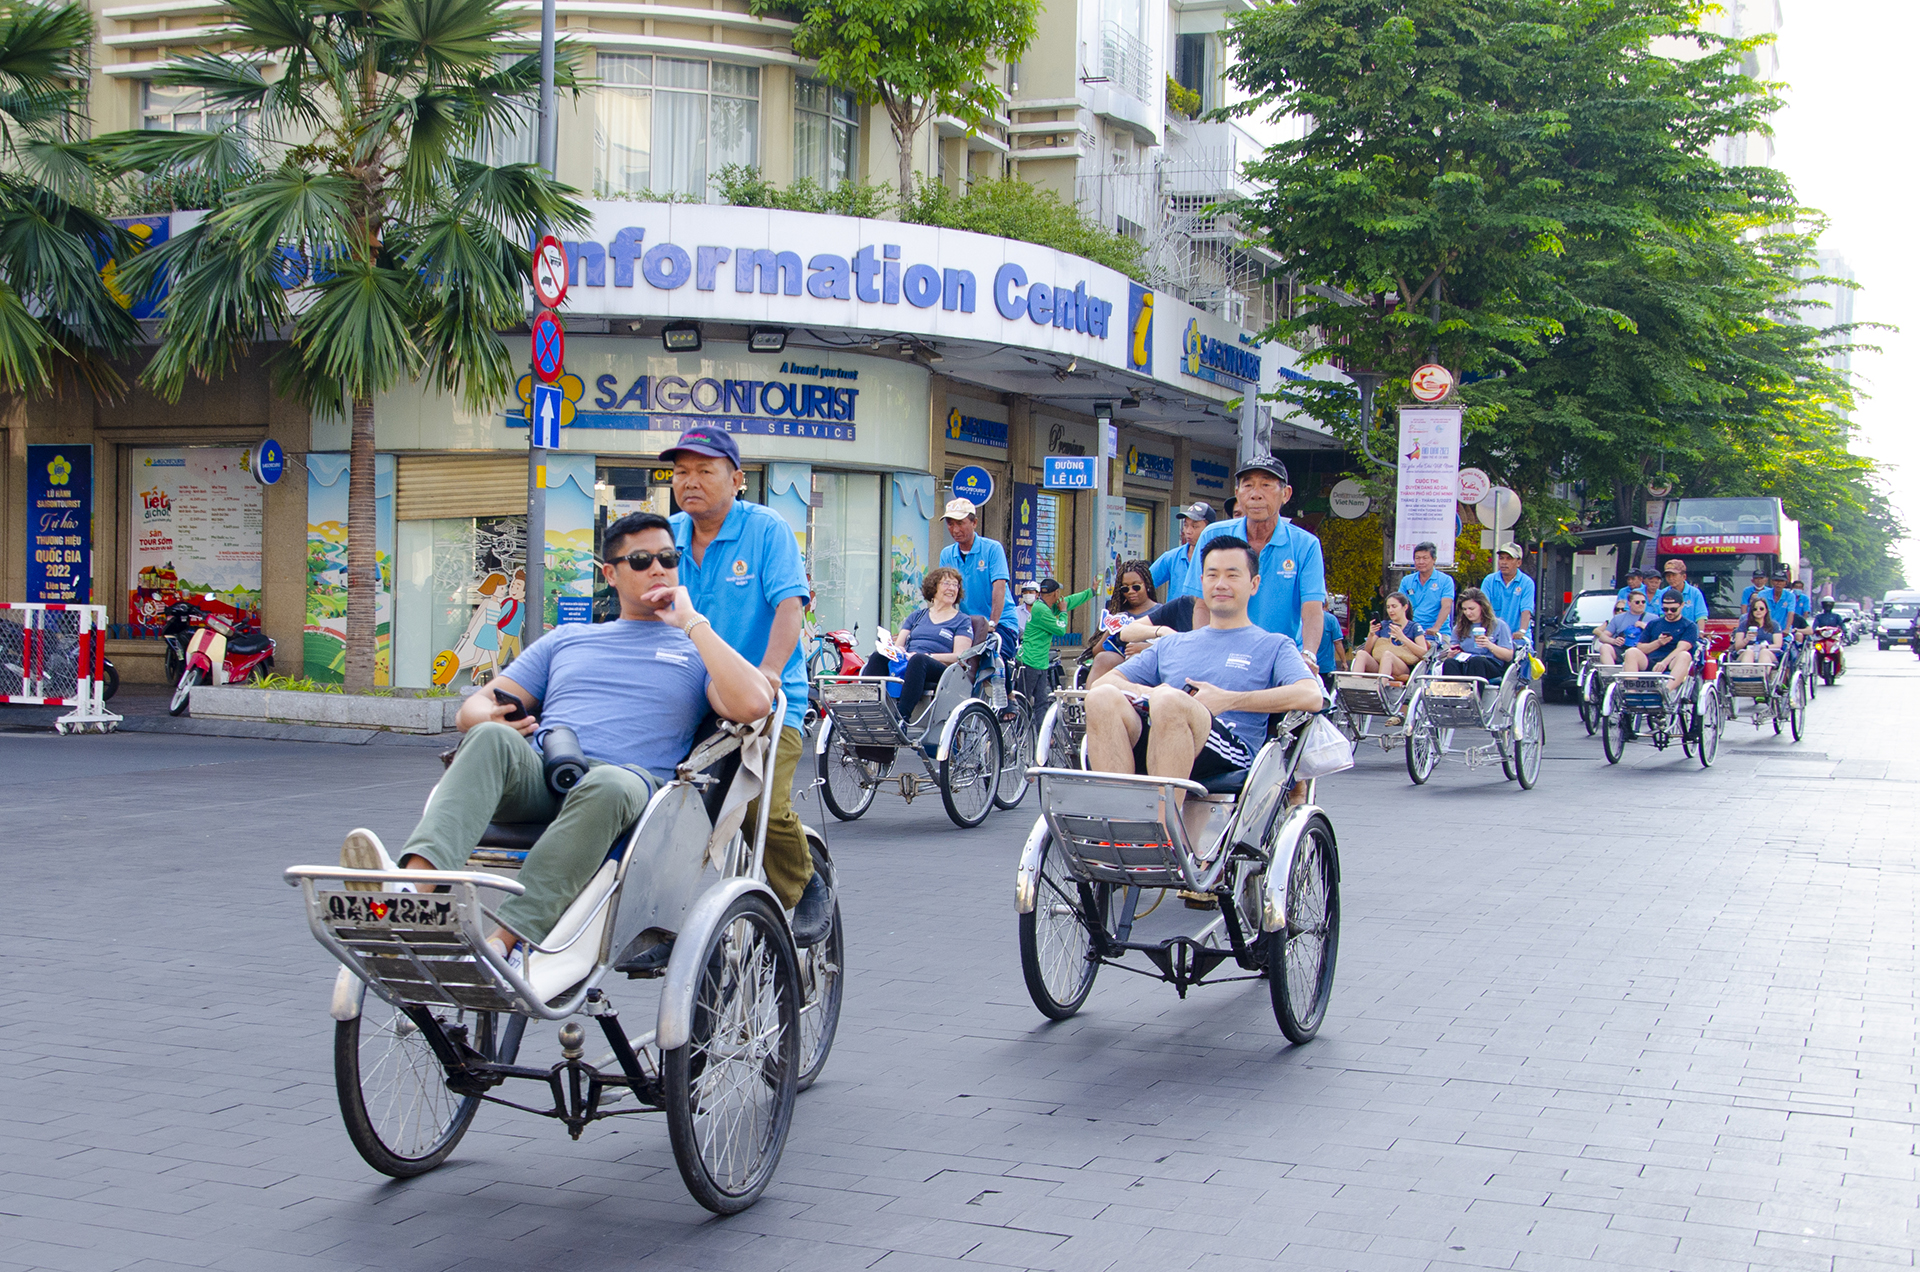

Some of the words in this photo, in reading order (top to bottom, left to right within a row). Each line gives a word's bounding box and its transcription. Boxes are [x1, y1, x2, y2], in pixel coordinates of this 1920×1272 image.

[530, 227, 975, 313] nformation
[994, 263, 1112, 339] Center
[780, 361, 788, 373] A
[790, 362, 819, 376] brand
[595, 374, 859, 421] SAIGONTOURIST
[656, 419, 748, 433] TRAVEL
[768, 423, 853, 439] SERVICE
[1055, 460, 1084, 470] ĐƯỜNG
[1052, 472, 1066, 485] LÊ
[1069, 473, 1087, 487] LỢI
[140, 486, 168, 509] Tết
[1672, 536, 1692, 546] HO
[1695, 536, 1720, 545] CHI
[1723, 536, 1760, 544] MINH
[36, 547, 62, 563] QUỐC
[64, 550, 81, 563] GIA
[46, 565, 70, 577] 2022
